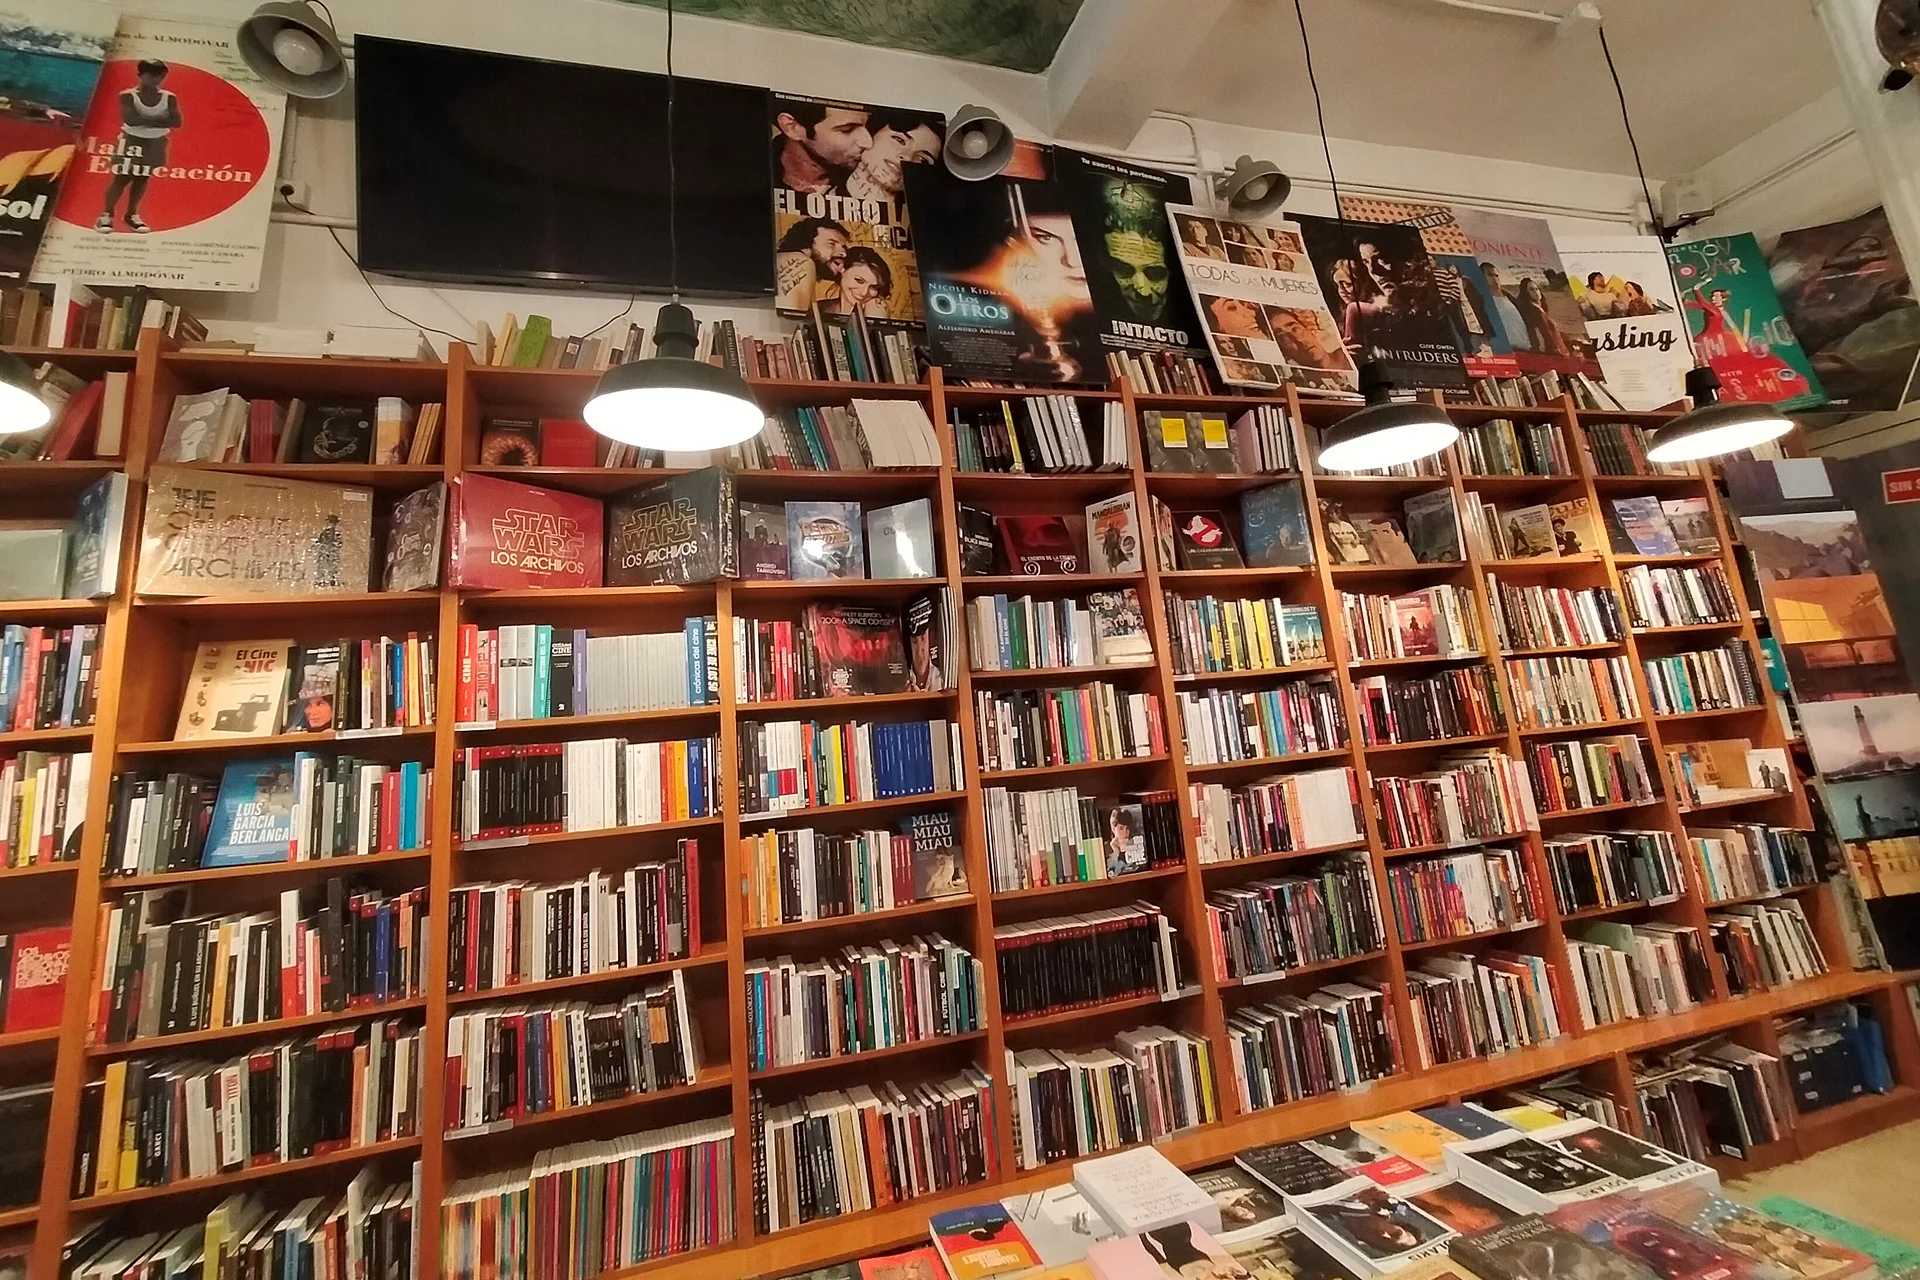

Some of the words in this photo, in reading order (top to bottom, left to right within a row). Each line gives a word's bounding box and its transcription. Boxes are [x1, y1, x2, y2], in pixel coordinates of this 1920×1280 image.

[87, 156, 252, 183] Educación
[774, 187, 801, 215] EL
[806, 194, 882, 225] OTRO
[62, 268, 106, 276] PEDRO
[111, 270, 185, 280] ALMODÓVAR
[1187, 262, 1241, 286] TODAS
[1259, 274, 1320, 296] MUJERES
[928, 283, 966, 293] NICOLE
[970, 286, 1010, 297] KIDMAN
[930, 293, 1010, 320] OTROS
[1111, 319, 1189, 346] INTACTO
[1373, 346, 1460, 365] INTRUDERS
[172, 487, 217, 510] THE
[1889, 480, 1913, 494] SIN
[491, 508, 585, 542] STAR
[622, 497, 697, 532] STAR
[492, 527, 585, 560] WARS
[621, 517, 697, 553] WARS
[490, 550, 518, 567] LOS
[519, 553, 585, 575] ARCHIVOS
[621, 552, 643, 569] LOS
[643, 540, 698, 565] ARCHIVOS
[164, 557, 306, 582] ARCHIVES
[847, 618, 868, 626] SPACE
[692, 628, 700, 645] cine
[236, 649, 247, 661] El
[250, 649, 278, 659] Cine
[692, 646, 700, 660] del
[461, 657, 471, 684] CINE
[692, 660, 702, 694] crónicas
[233, 813, 275, 831] GARCÍA
[237, 802, 264, 817] LUIS
[912, 812, 949, 829] MIAU
[229, 827, 289, 846] BERLANGA
[913, 824, 951, 841] MIAU
[915, 836, 953, 853] MIAU
[600, 885, 607, 894] H
[746, 980, 754, 1024] SOLÓRZANO
[940, 990, 949, 1019] FÚTBOL
[154, 1132, 163, 1157] GARCI
